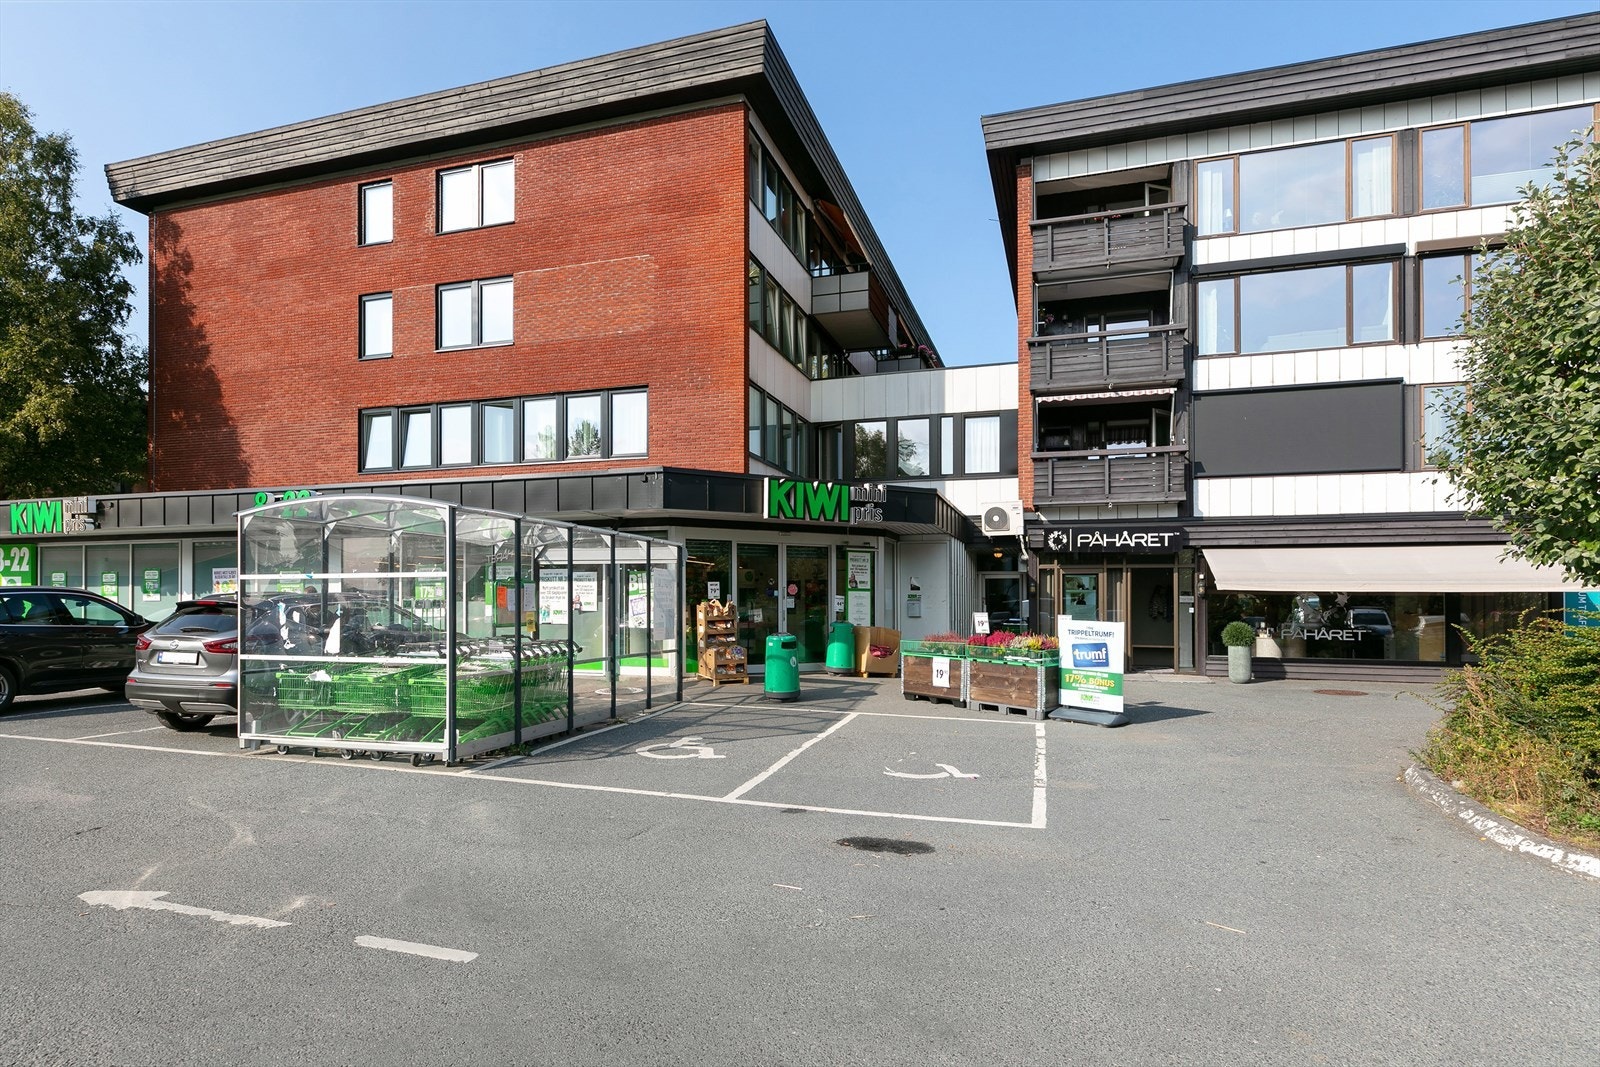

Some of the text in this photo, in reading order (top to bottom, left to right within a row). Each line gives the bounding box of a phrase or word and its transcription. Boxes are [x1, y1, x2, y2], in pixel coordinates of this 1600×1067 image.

[764, 478, 850, 521] KIWI
[853, 483, 887, 502] mini
[64, 497, 88, 514] mini
[851, 503, 883, 525] pris
[10, 501, 63, 535] KIWI
[64, 514, 86, 534] pris
[1068, 629, 1115, 638] TRIPPELTRUMF!
[1074, 647, 1107, 660] trumf
[1065, 673, 1087, 684] 17%
[1088, 677, 1115, 687] BONUS
